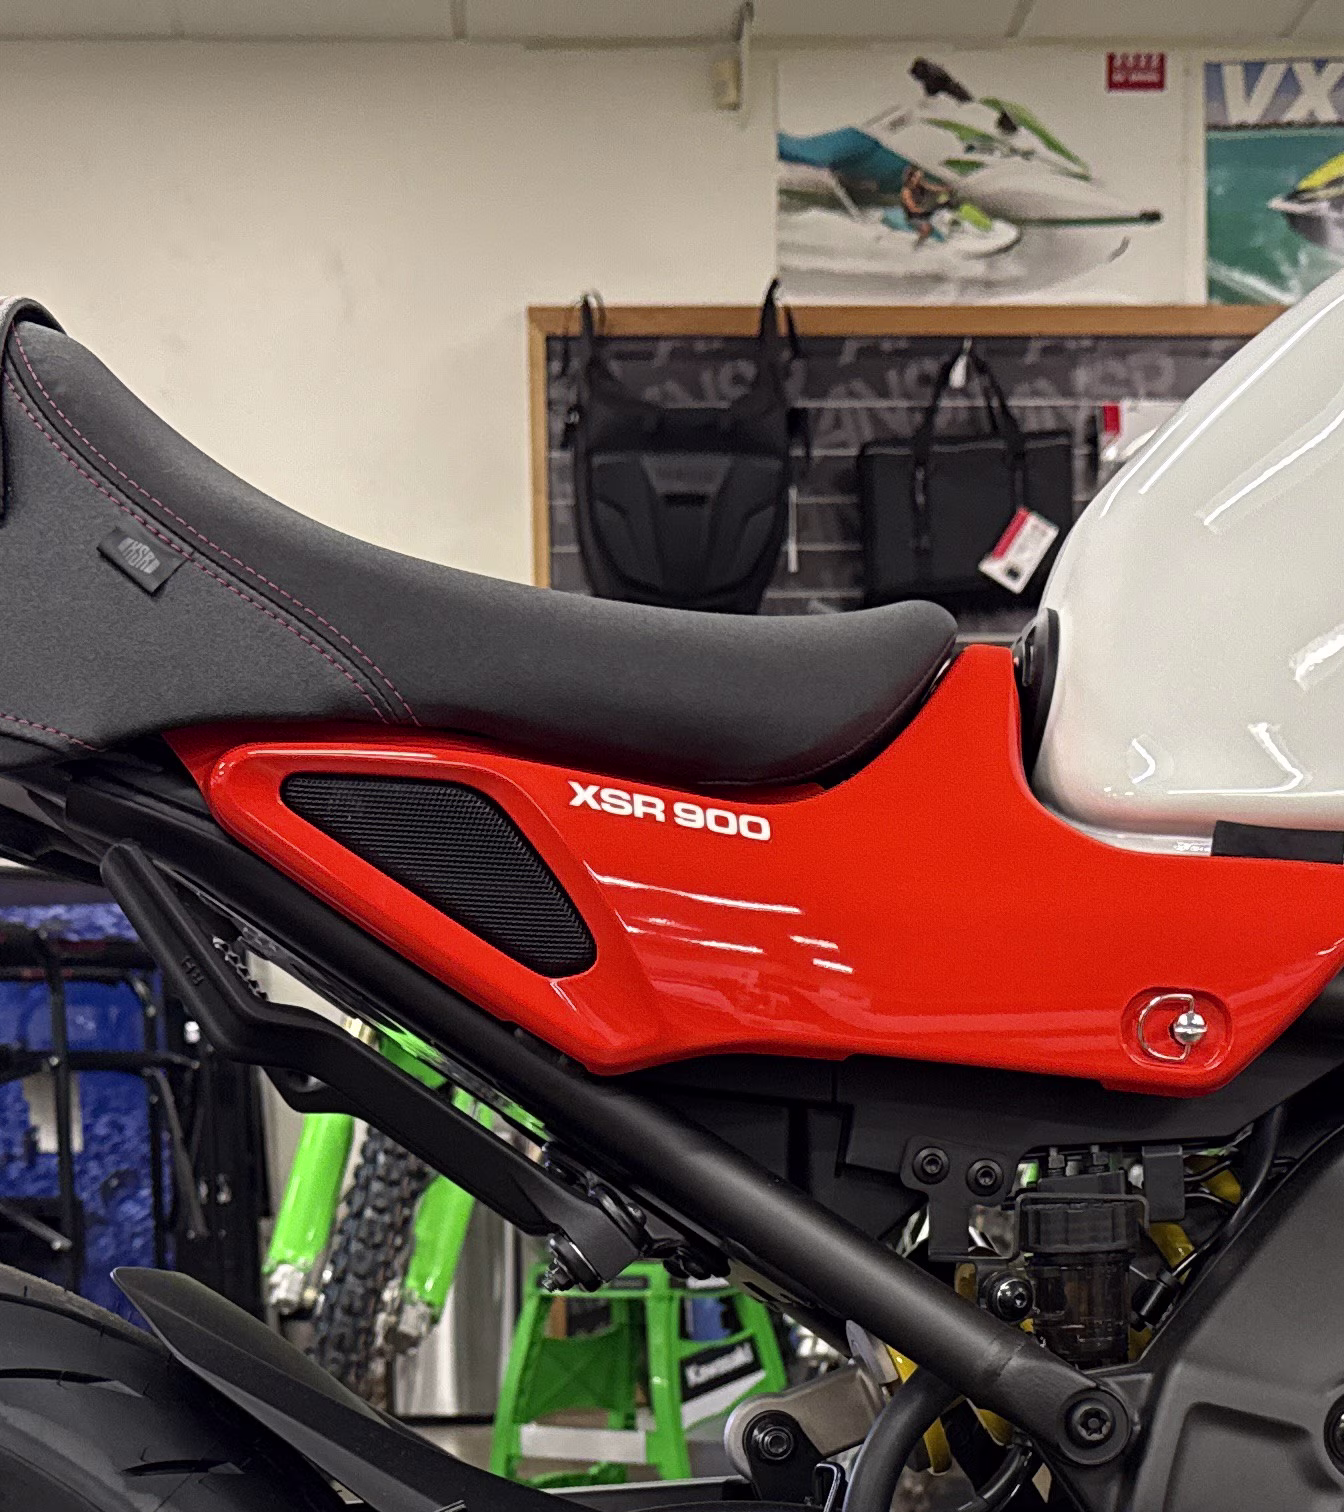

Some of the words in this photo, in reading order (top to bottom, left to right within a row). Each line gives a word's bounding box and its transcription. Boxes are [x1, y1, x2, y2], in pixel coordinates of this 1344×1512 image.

[120, 538, 159, 573] XSR
[567, 780, 666, 823] XSR
[673, 801, 771, 841] 900
